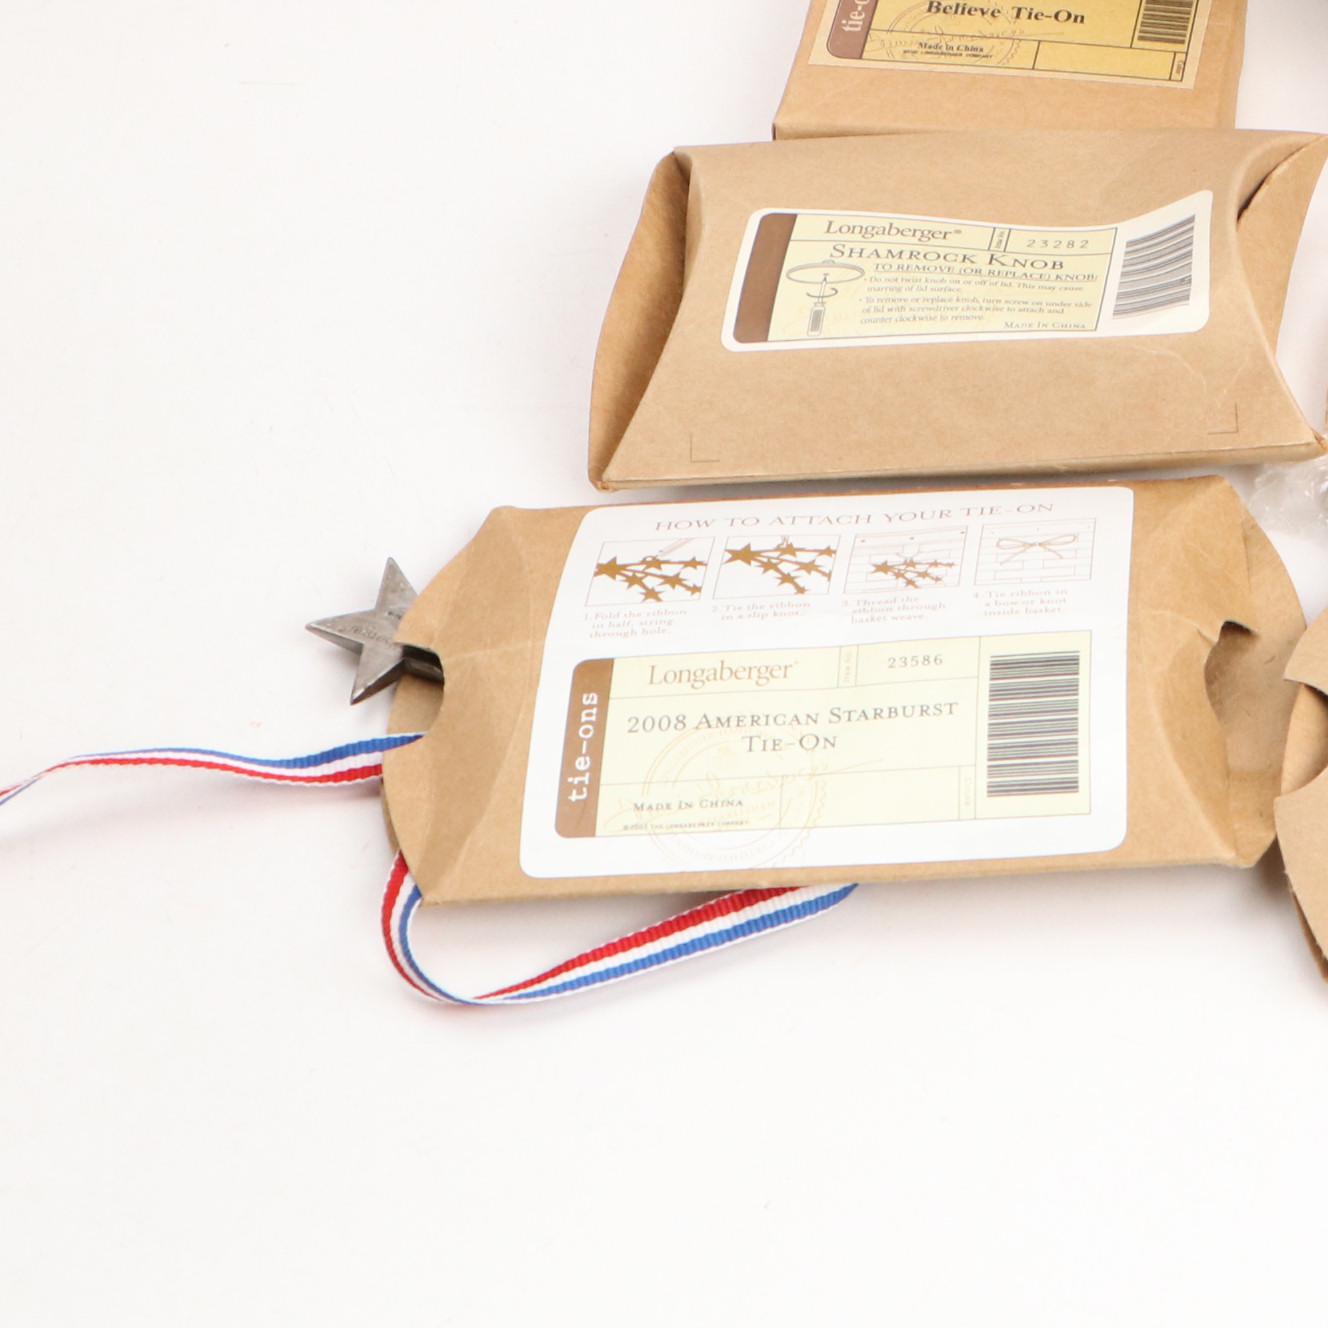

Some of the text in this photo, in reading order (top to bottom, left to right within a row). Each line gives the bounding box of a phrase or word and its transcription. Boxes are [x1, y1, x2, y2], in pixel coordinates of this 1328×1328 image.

[926, 0, 1085, 24] Believe Tie-On
[1026, 239, 1089, 249] 23282
[830, 243, 1064, 270] SHAMROCK KNOB
[655, 518, 717, 532] HOW
[724, 515, 761, 529] TO
[767, 513, 873, 528] ATTACH
[883, 508, 953, 525] YOUR
[887, 653, 944, 670] 23586
[627, 701, 960, 734] 2008 AMERICAN STARBURST
[567, 691, 599, 803] tie-ons
[741, 732, 839, 753] TIE-ON
